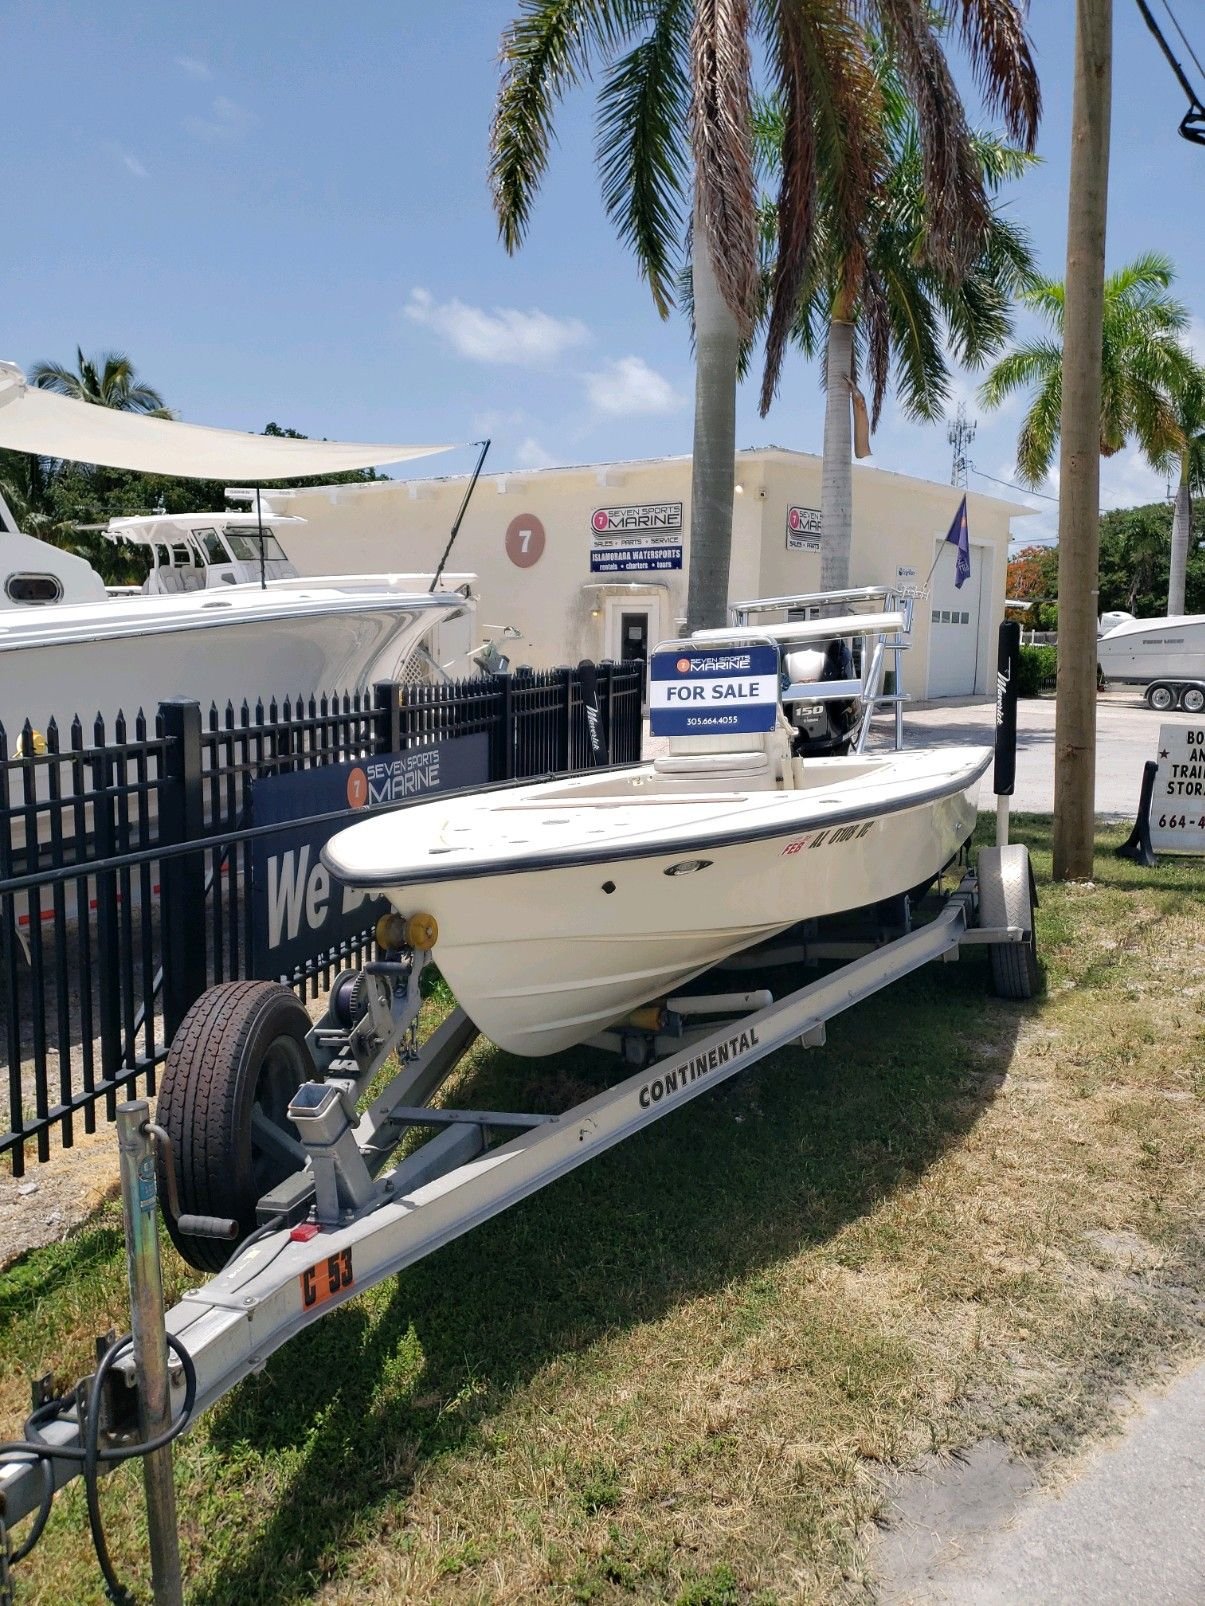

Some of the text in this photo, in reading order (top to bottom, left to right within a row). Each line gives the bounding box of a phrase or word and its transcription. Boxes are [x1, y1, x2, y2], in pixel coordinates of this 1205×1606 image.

[608, 505, 681, 518] SEVEN SPORTS
[598, 513, 681, 529] 7 MARINE
[518, 530, 532, 553] 7
[594, 540, 614, 548] SALES
[650, 536, 679, 544] SERVICE
[592, 549, 681, 562] ISLAMORADA WATERSPORTS
[625, 561, 649, 570] charters
[718, 654, 751, 662] SPORTS
[690, 660, 751, 672] MARINE
[666, 682, 760, 701] FOR SALE
[795, 705, 824, 717] 150
[686, 715, 738, 726] 305.664.4055
[366, 749, 440, 781] SEVEN SPORTS
[353, 763, 440, 805] 7 MARINE
[1167, 781, 1205, 796] STOR
[781, 841, 805, 856] FEB
[267, 844, 330, 950] We
[639, 1027, 760, 1109] CONTINENTAL
[303, 1246, 353, 1307] C 53
